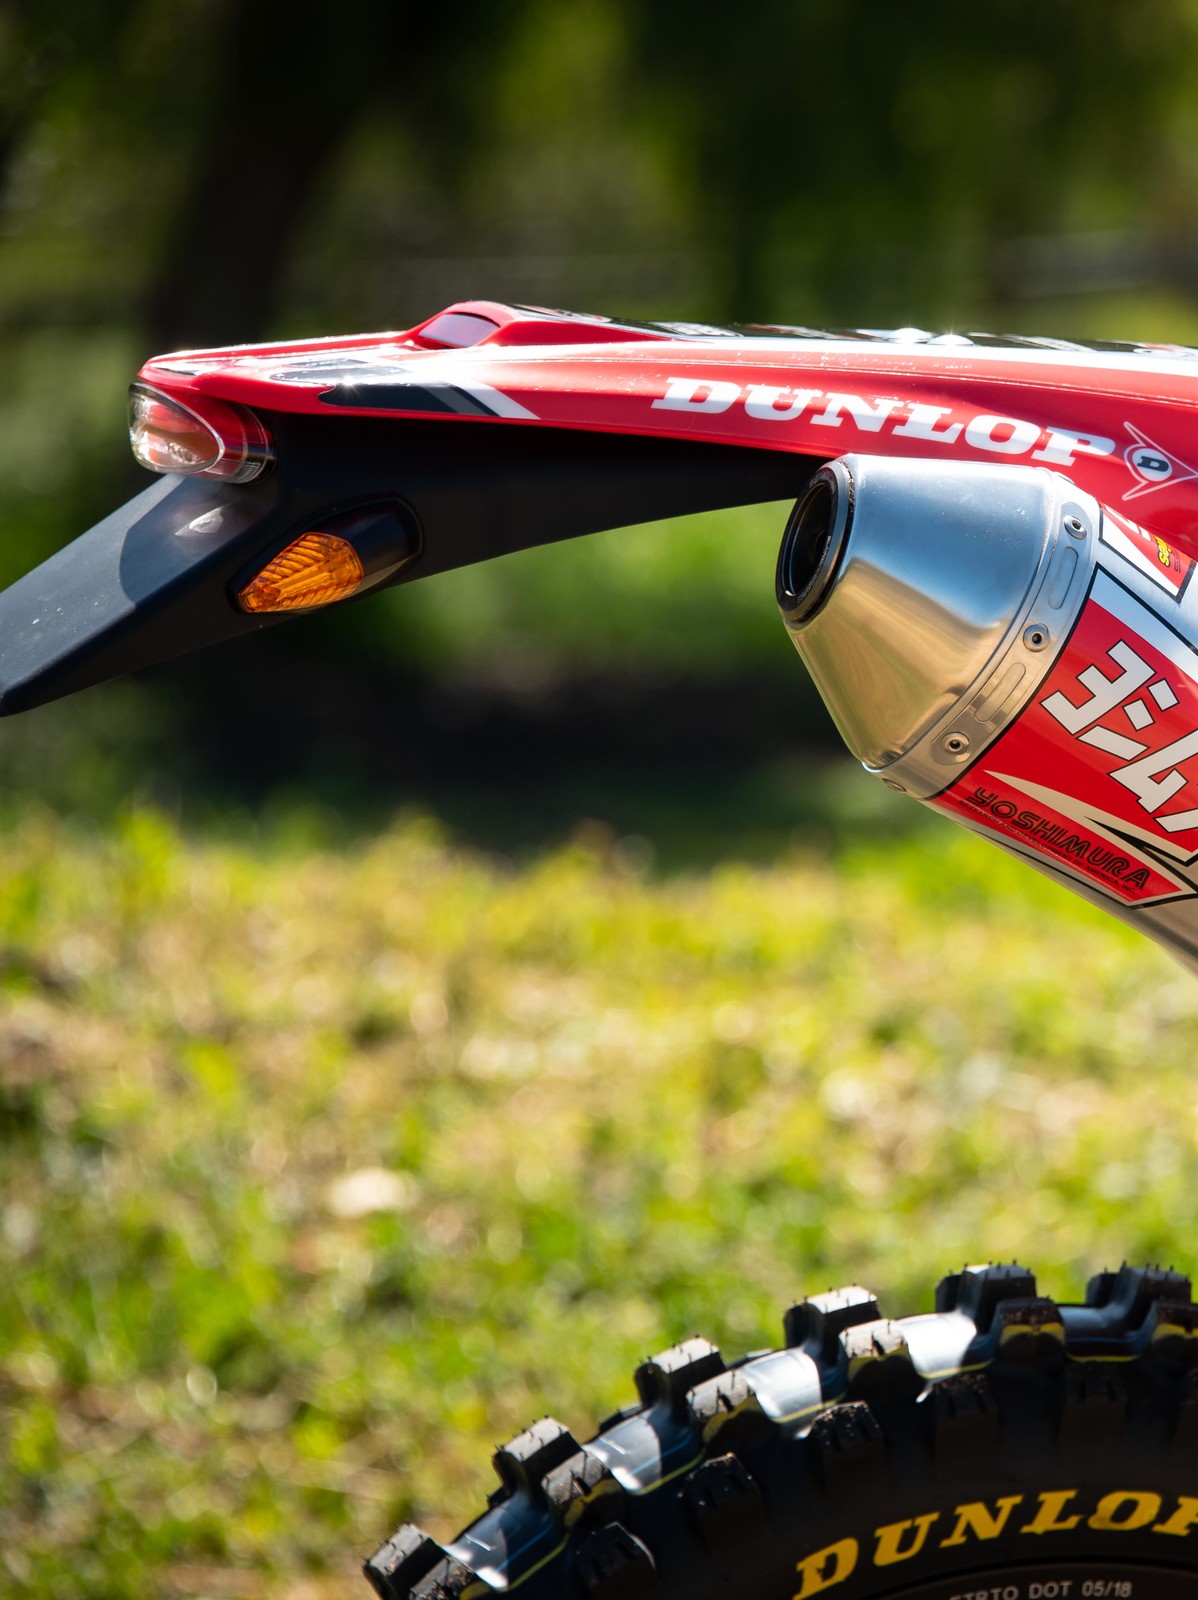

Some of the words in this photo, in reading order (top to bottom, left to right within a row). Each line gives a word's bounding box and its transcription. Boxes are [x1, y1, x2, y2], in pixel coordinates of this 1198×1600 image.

[650, 376, 1116, 467] DUNLOP
[1136, 455, 1170, 473] D
[966, 786, 1151, 889] YOSHIMURA
[1029, 1581, 1073, 1599] DOT
[1081, 1580, 1133, 1598] 05/18
